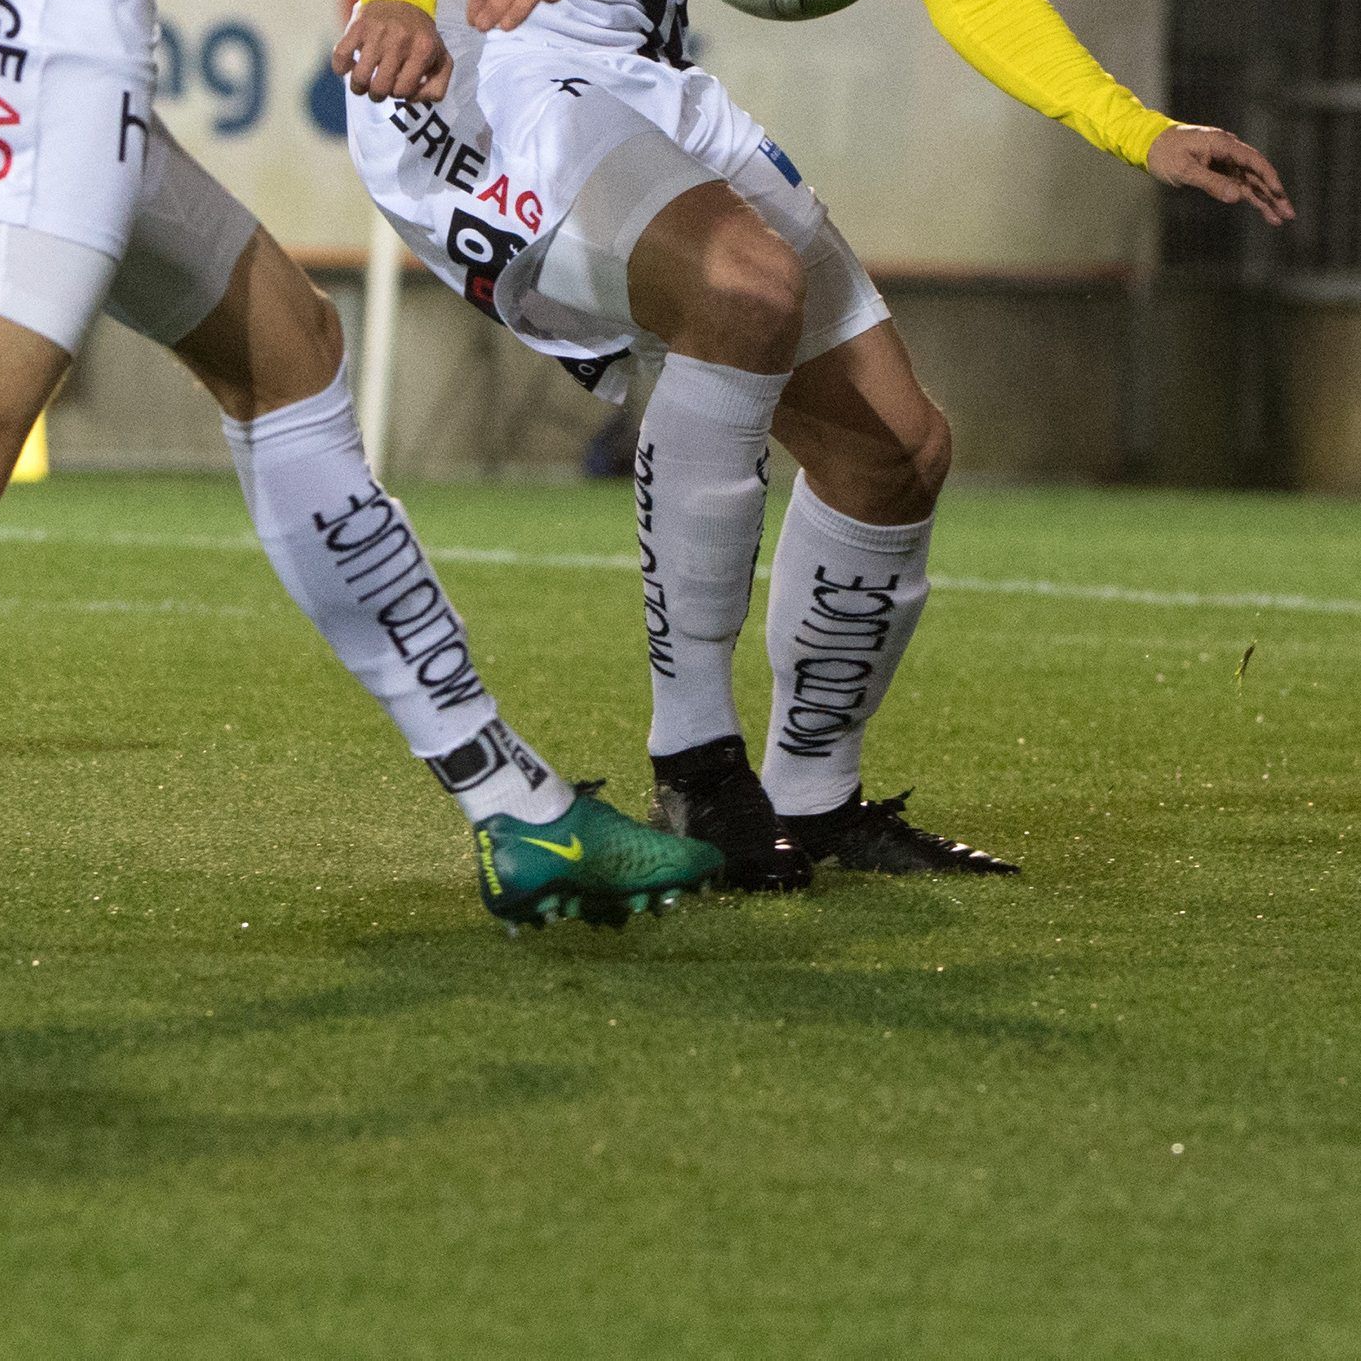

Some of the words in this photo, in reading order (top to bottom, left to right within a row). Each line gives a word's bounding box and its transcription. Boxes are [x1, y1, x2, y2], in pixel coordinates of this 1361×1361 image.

[312, 479, 424, 605] LUCE
[377, 577, 486, 711] MOLTO
[796, 565, 900, 651] LUCE
[777, 657, 872, 757] MOLTO
